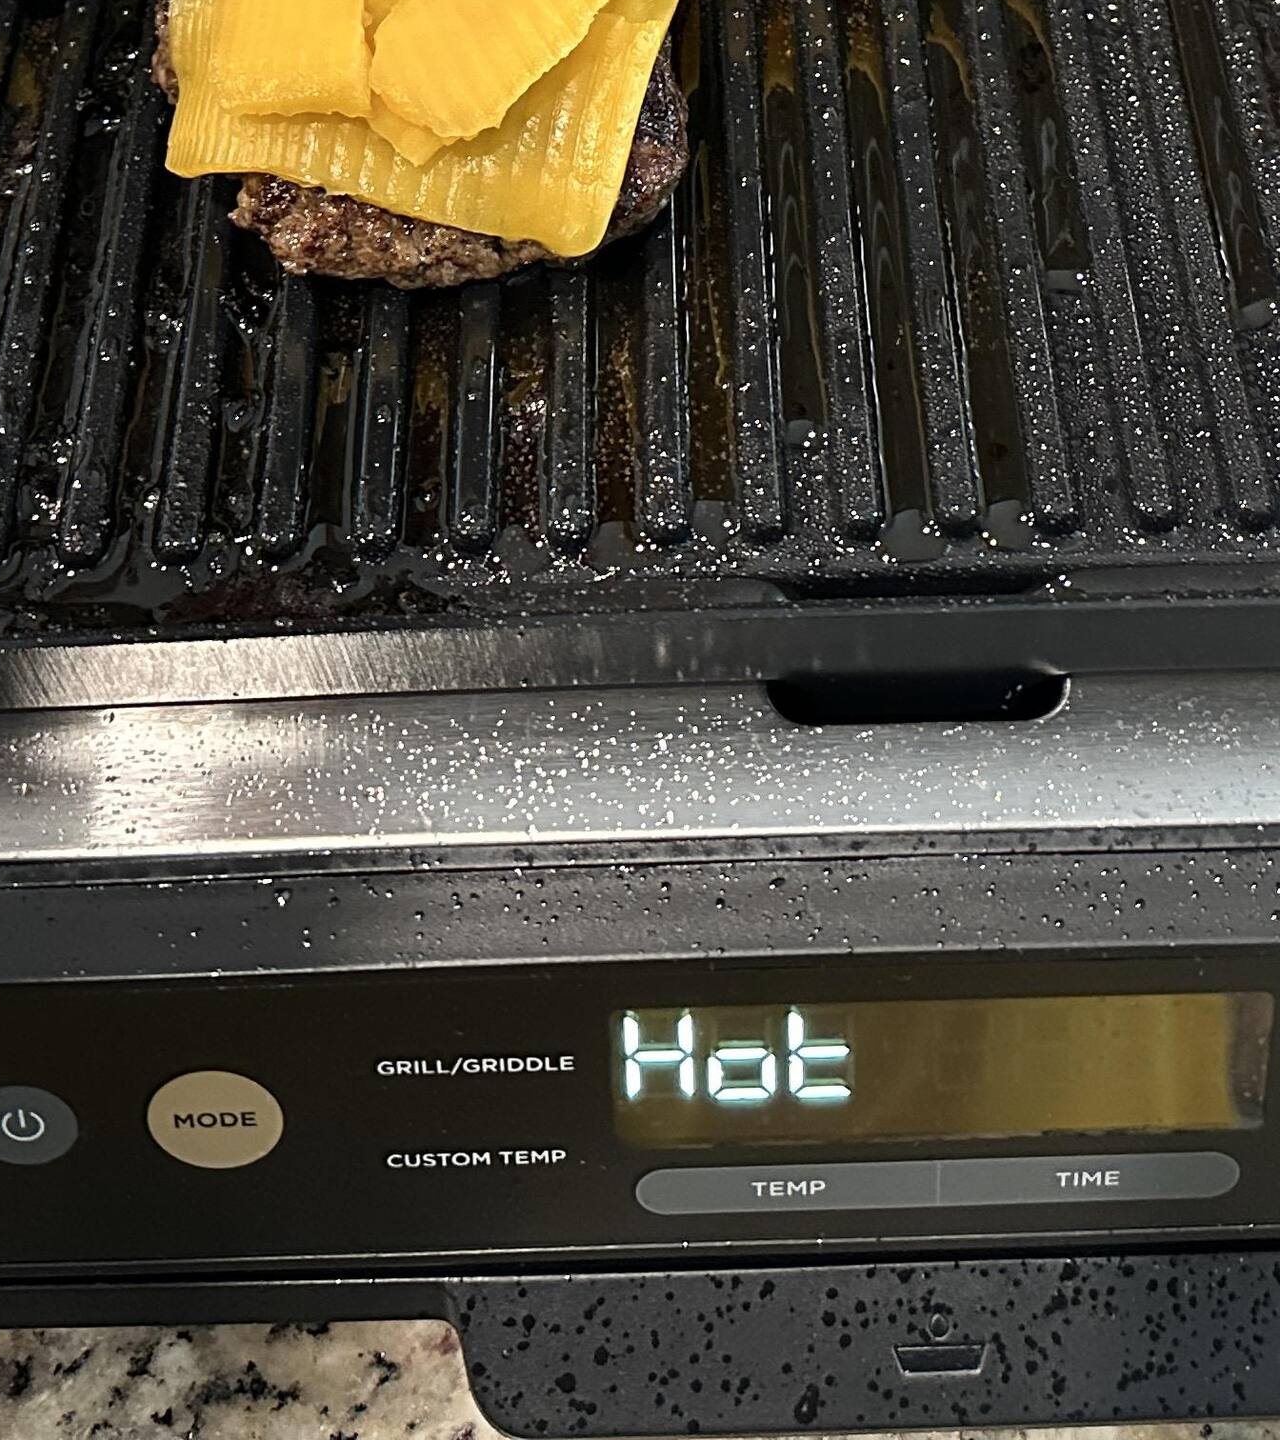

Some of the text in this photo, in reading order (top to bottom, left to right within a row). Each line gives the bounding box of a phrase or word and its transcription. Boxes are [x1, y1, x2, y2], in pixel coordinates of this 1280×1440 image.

[622, 1010, 852, 1102] Hot
[376, 1056, 575, 1076] GRILL/GRIDDLE
[173, 1111, 258, 1129] MODE
[386, 1148, 567, 1169] CUSTOM TEMP
[751, 1180, 827, 1197] TEMP
[1055, 1171, 1121, 1187] TIME
